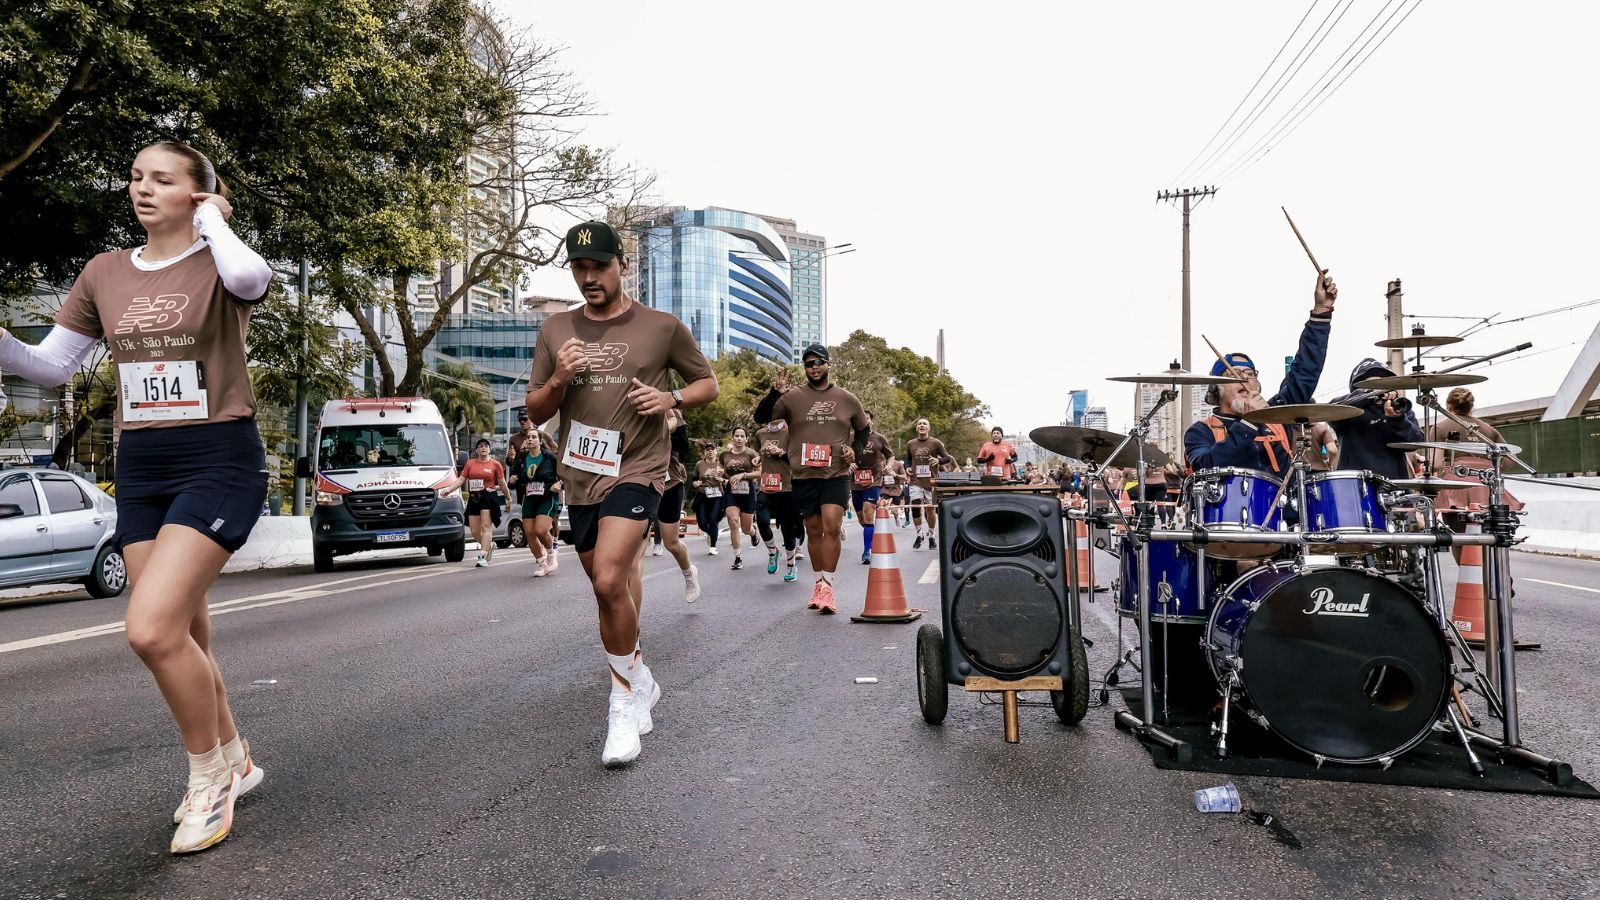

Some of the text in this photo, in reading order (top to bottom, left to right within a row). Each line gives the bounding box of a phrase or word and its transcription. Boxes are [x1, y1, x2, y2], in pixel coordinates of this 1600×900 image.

[577, 228, 592, 245] NY
[116, 334, 195, 351] 15k São Paulo
[143, 376, 182, 401] 1514
[590, 375, 603, 384] São
[605, 374, 627, 384] Paulo
[578, 436, 608, 460] 1877
[1302, 586, 1370, 615] Pearl
